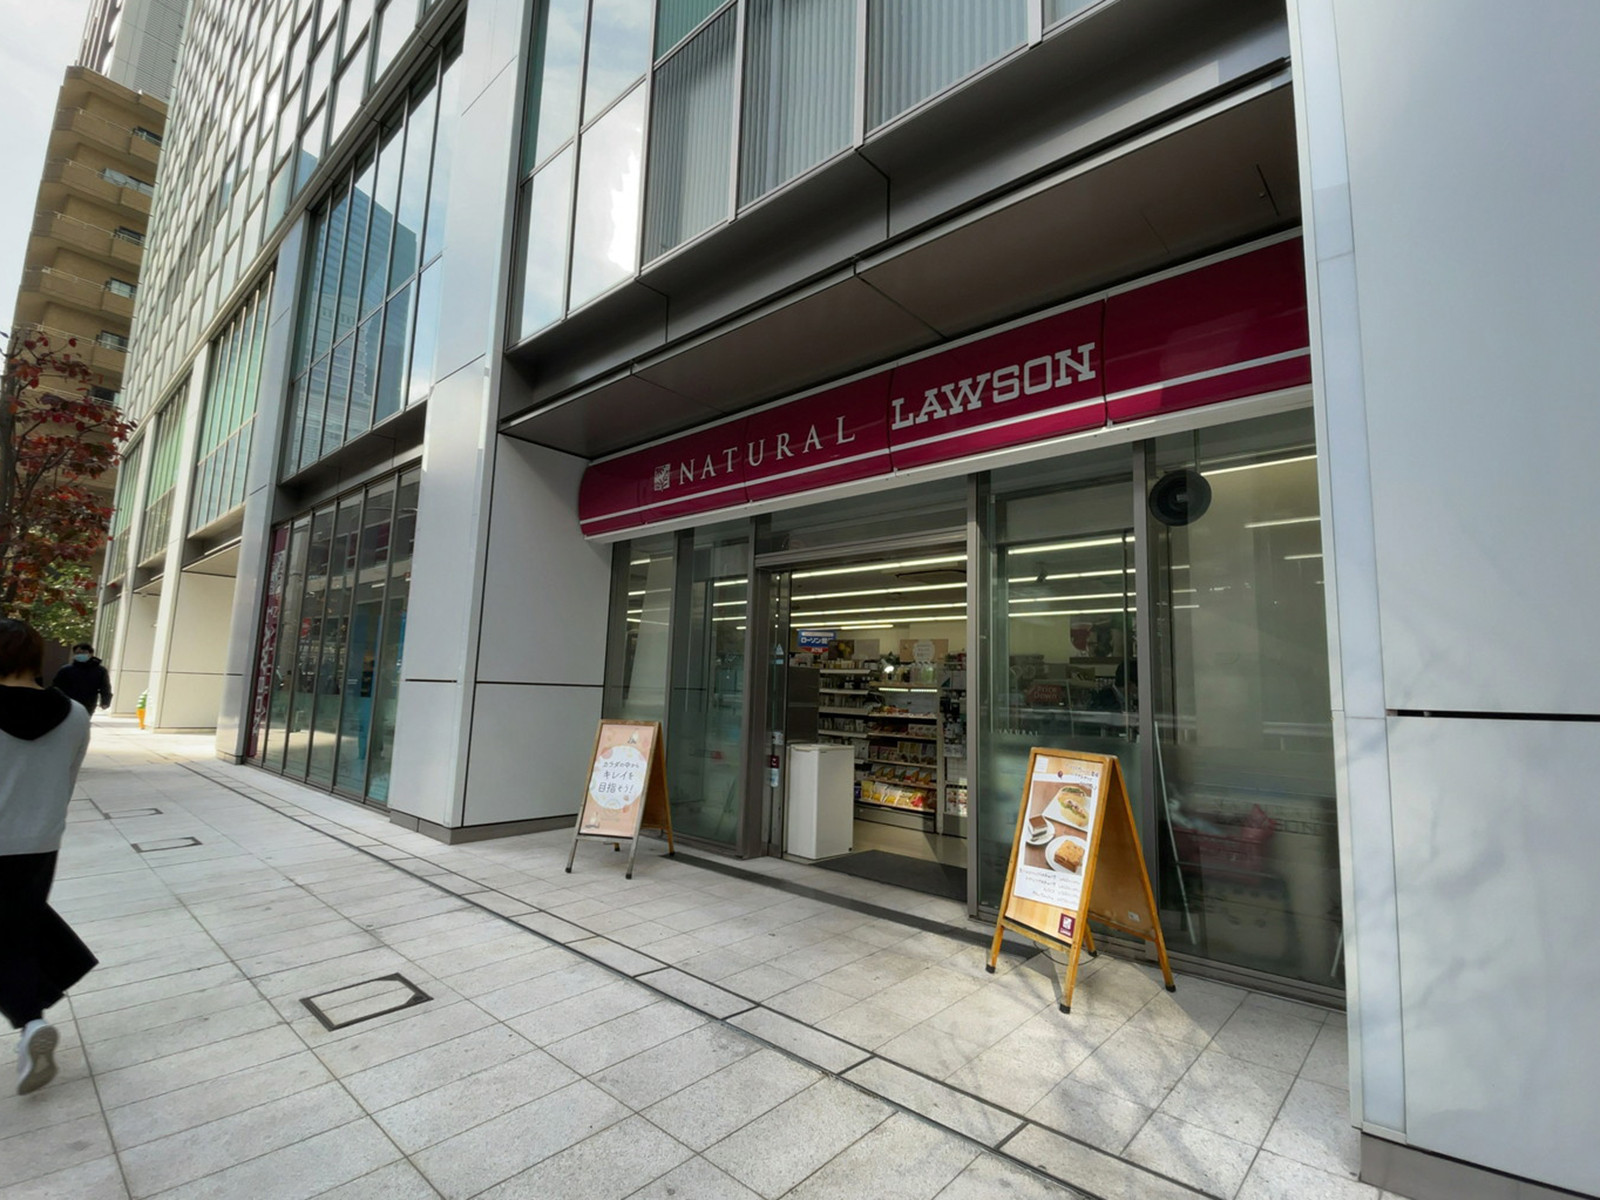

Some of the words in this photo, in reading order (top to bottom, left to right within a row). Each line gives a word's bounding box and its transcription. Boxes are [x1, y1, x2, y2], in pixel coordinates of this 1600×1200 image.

[679, 415, 856, 485] NATURAL
[891, 342, 1097, 431] LAWSON
[604, 770, 634, 780] キレイを
